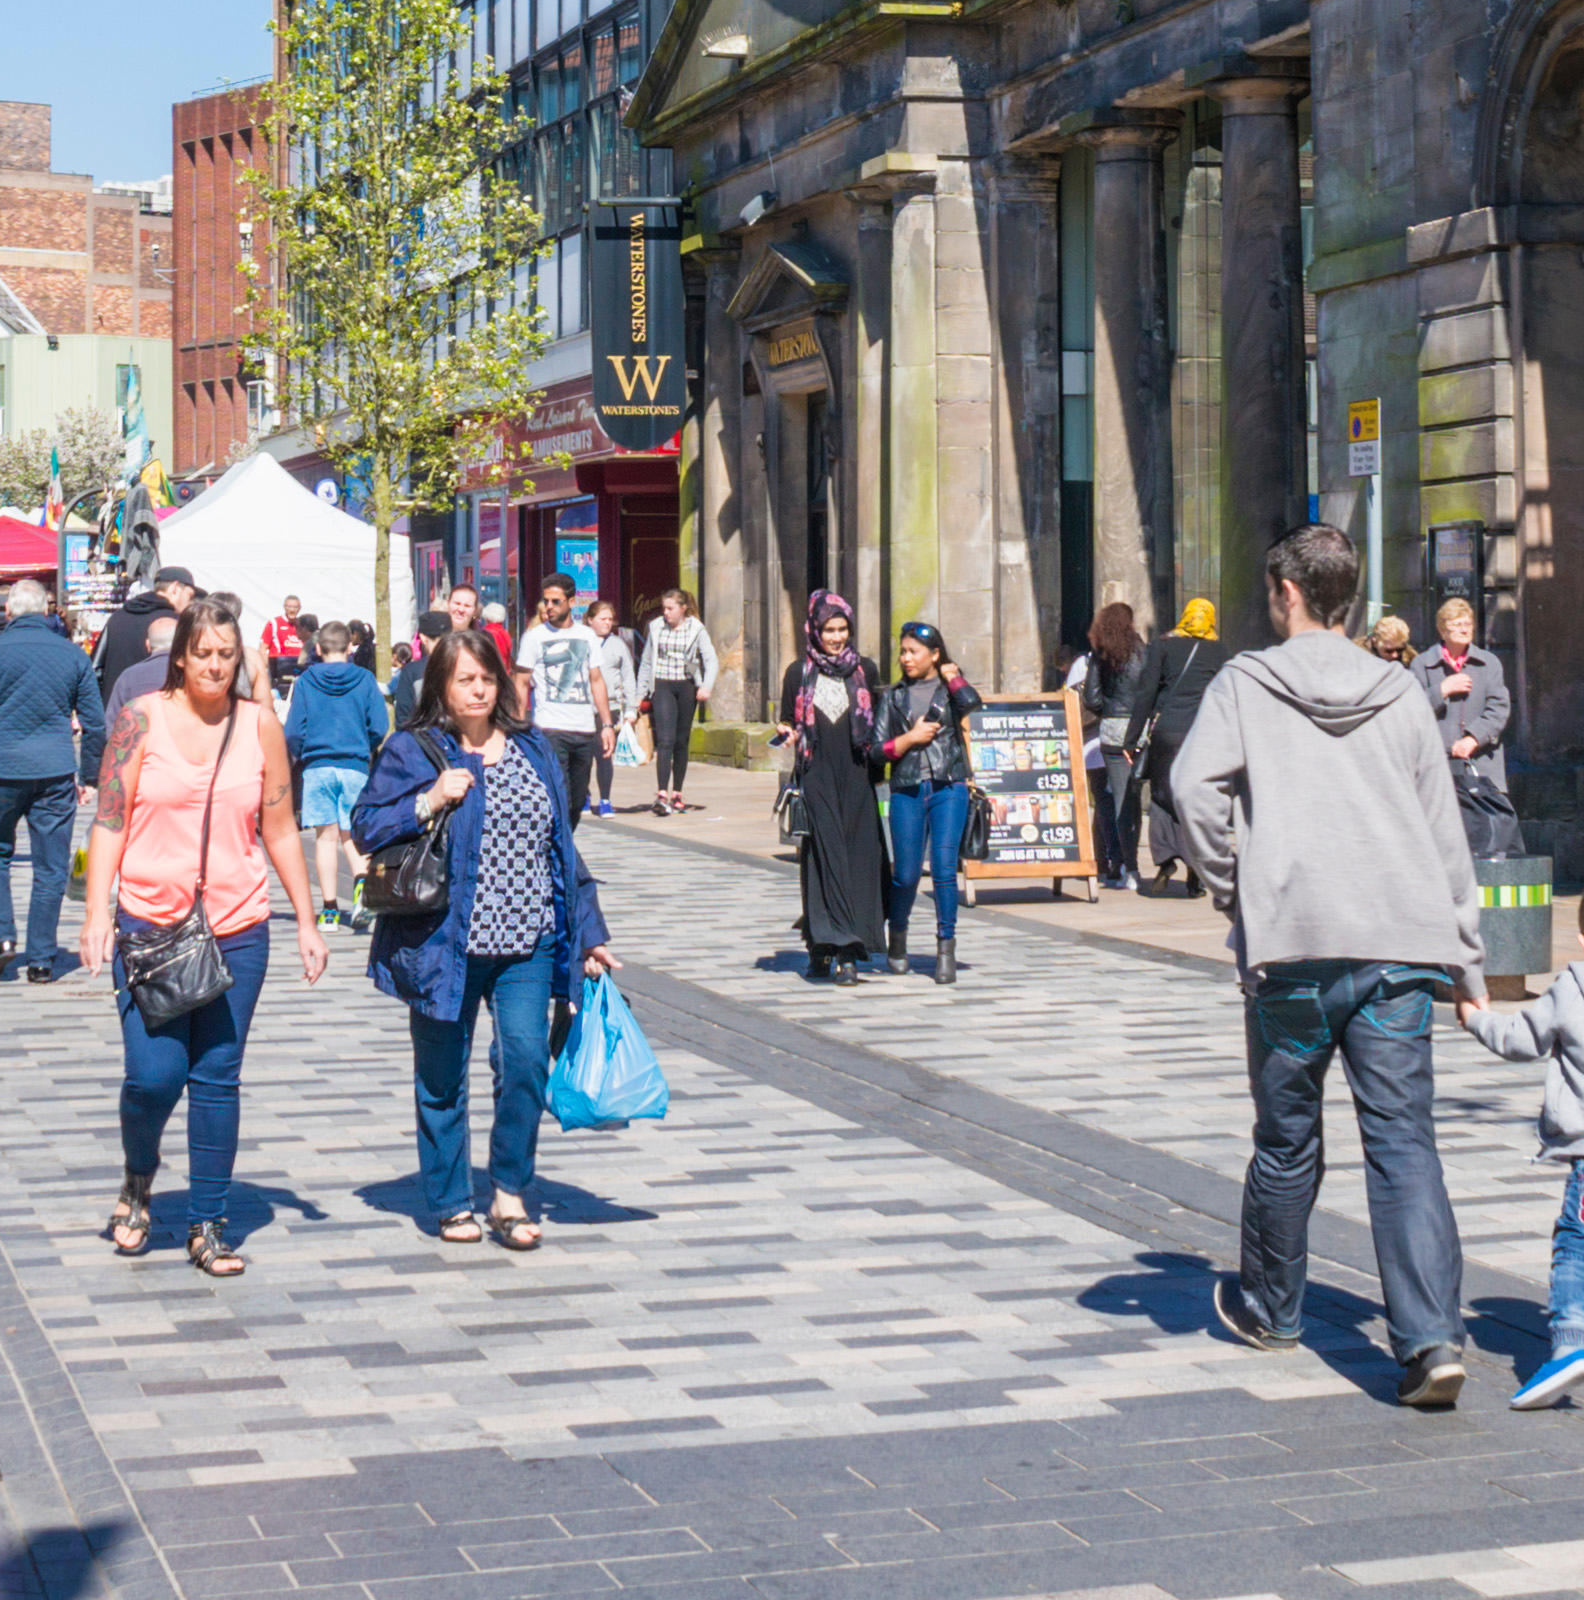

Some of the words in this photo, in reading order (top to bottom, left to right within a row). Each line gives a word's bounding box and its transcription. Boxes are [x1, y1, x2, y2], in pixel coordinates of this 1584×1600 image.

[629, 213, 647, 343] WATERSTONE'S
[606, 355, 672, 401] W
[601, 405, 680, 416] WATERSTONE'S
[533, 429, 593, 459] AMUSEMENTS
